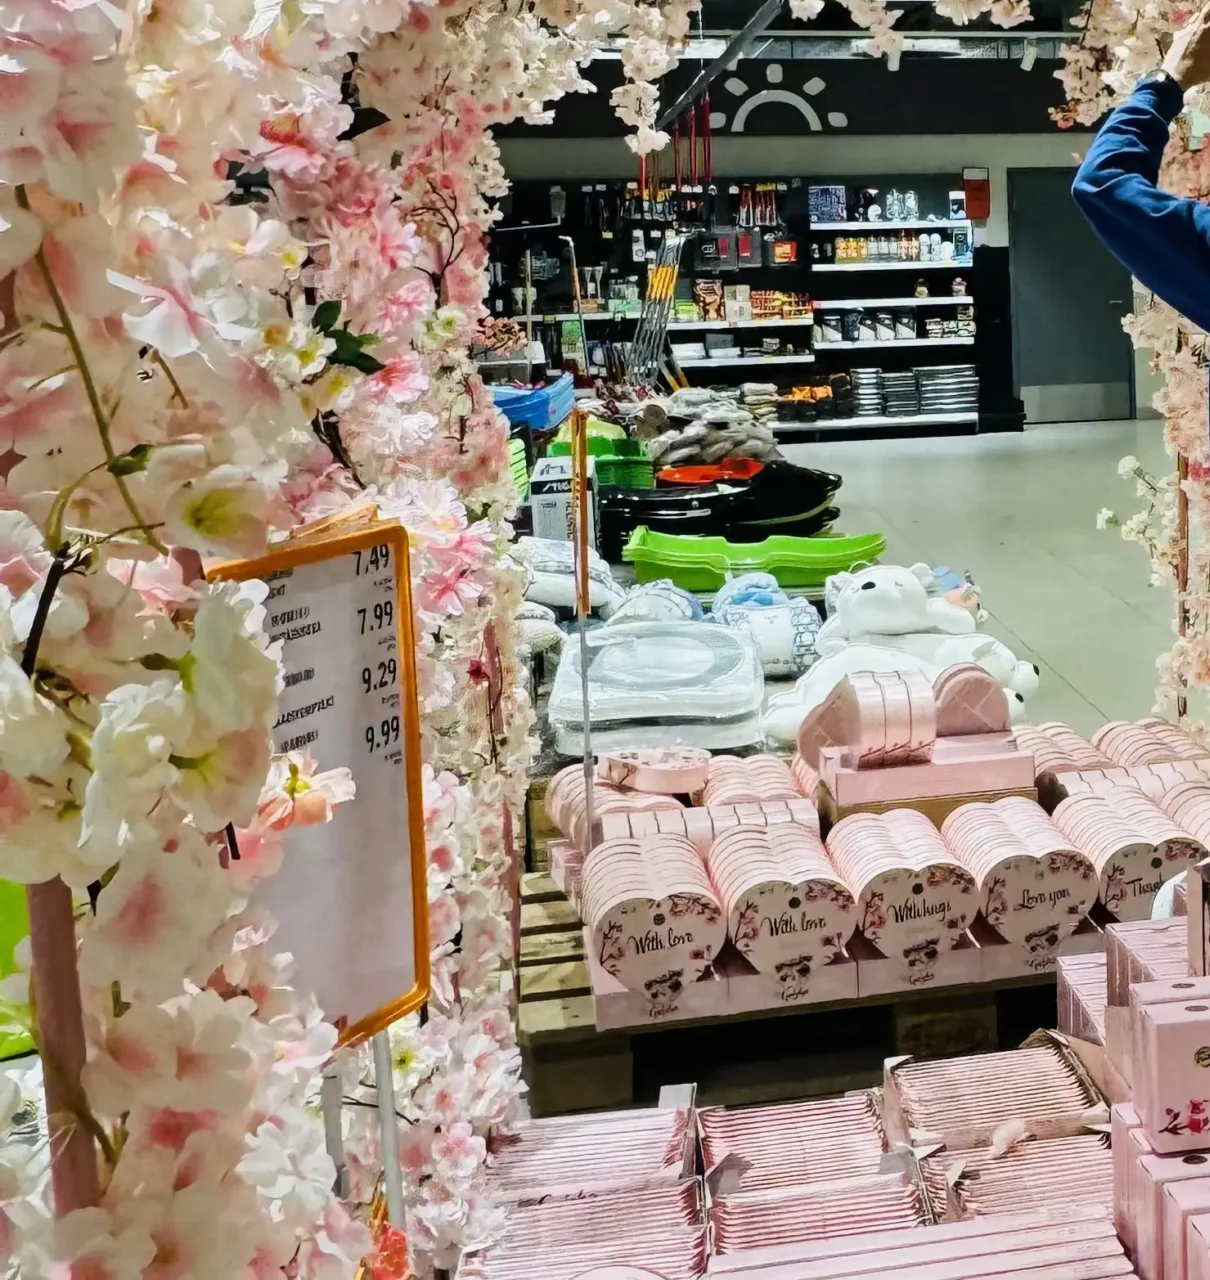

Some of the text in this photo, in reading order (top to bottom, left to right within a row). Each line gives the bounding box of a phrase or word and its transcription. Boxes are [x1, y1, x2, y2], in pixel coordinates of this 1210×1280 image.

[357, 600, 393, 635] 7.99
[362, 658, 397, 694] 9.29
[366, 716, 400, 754] 9.99
